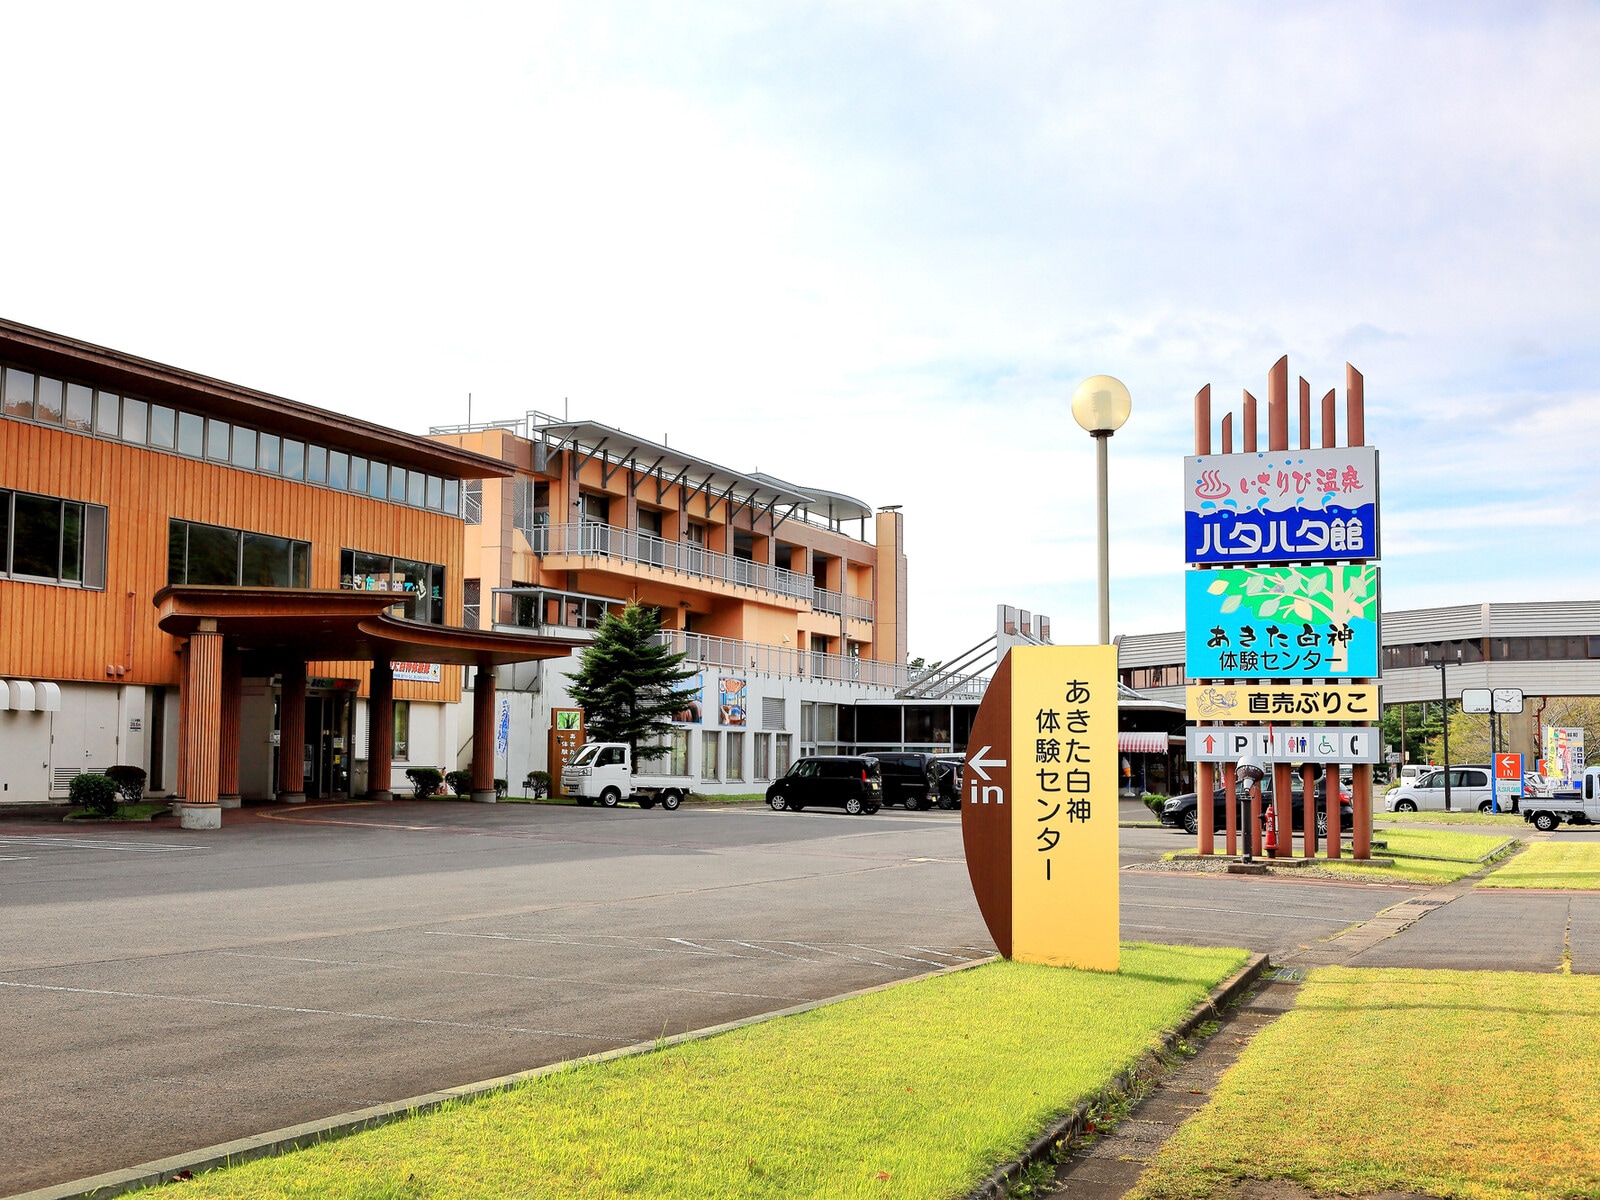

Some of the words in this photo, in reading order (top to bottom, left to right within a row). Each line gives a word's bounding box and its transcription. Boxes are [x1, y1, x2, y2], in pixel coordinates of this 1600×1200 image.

[1240, 464, 1364, 497] いさりび温泉
[1196, 517, 1364, 556] ハタハタ館
[1207, 623, 1355, 649] あきた白神
[1219, 650, 1342, 672] 体験センター
[1248, 691, 1368, 715] 直売ぶりこ
[1065, 679, 1091, 824] あきた白神
[1235, 735, 1248, 752] P
[1503, 769, 1514, 777] IN
[970, 779, 1004, 804] in
[1036, 708, 1061, 881] 体験センター
